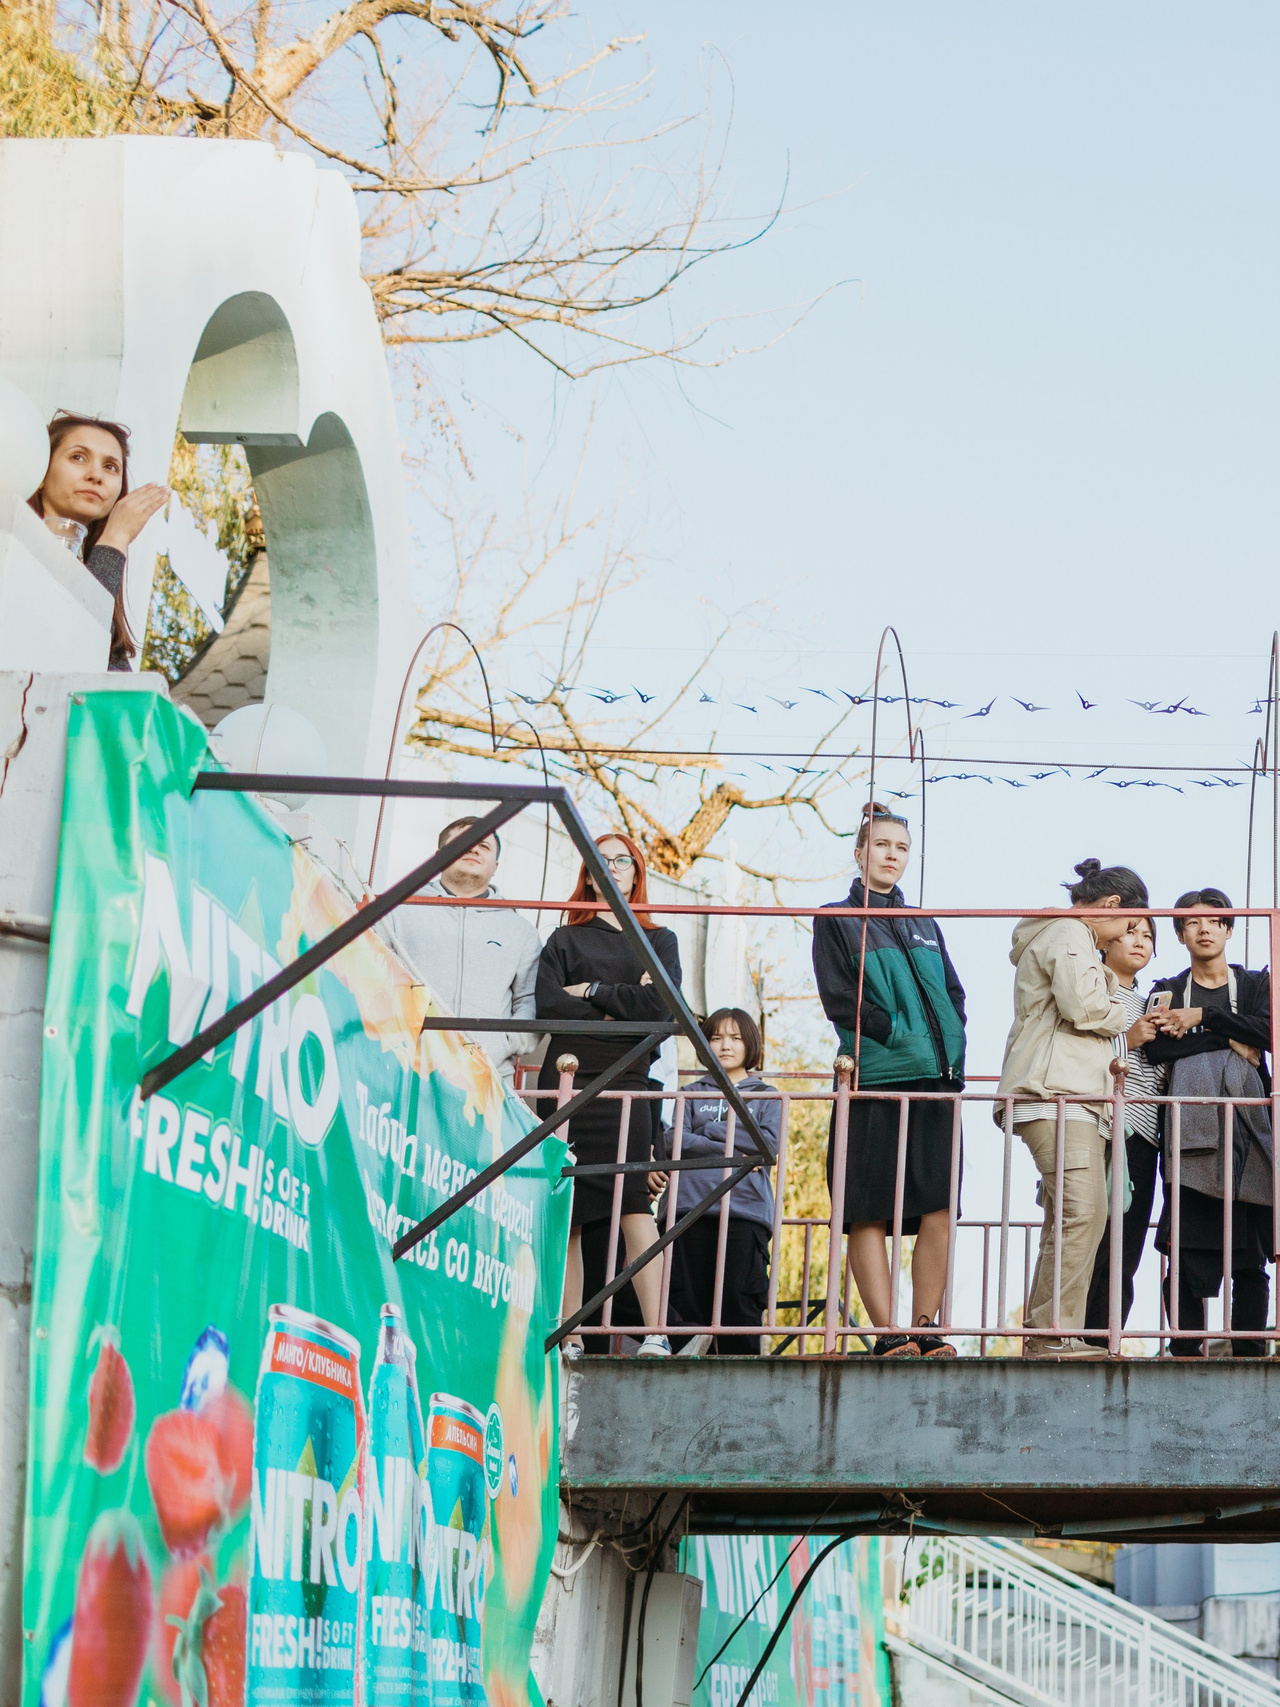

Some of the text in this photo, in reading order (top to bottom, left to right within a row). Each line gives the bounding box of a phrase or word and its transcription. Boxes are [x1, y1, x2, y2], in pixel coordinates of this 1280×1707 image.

[126, 852, 340, 1146] NITRO
[130, 1083, 265, 1225] FRESH!
[264, 1158, 310, 1216] SOFT
[261, 1195, 310, 1253] DRINK
[445, 1237, 470, 1283] со
[445, 1424, 478, 1453] АПЕЛЬСИН
[250, 1467, 362, 1594] NITRO
[252, 1613, 323, 1670] FRESH!
[323, 1646, 353, 1670] DRINK
[324, 1619, 354, 1645] SOFT
